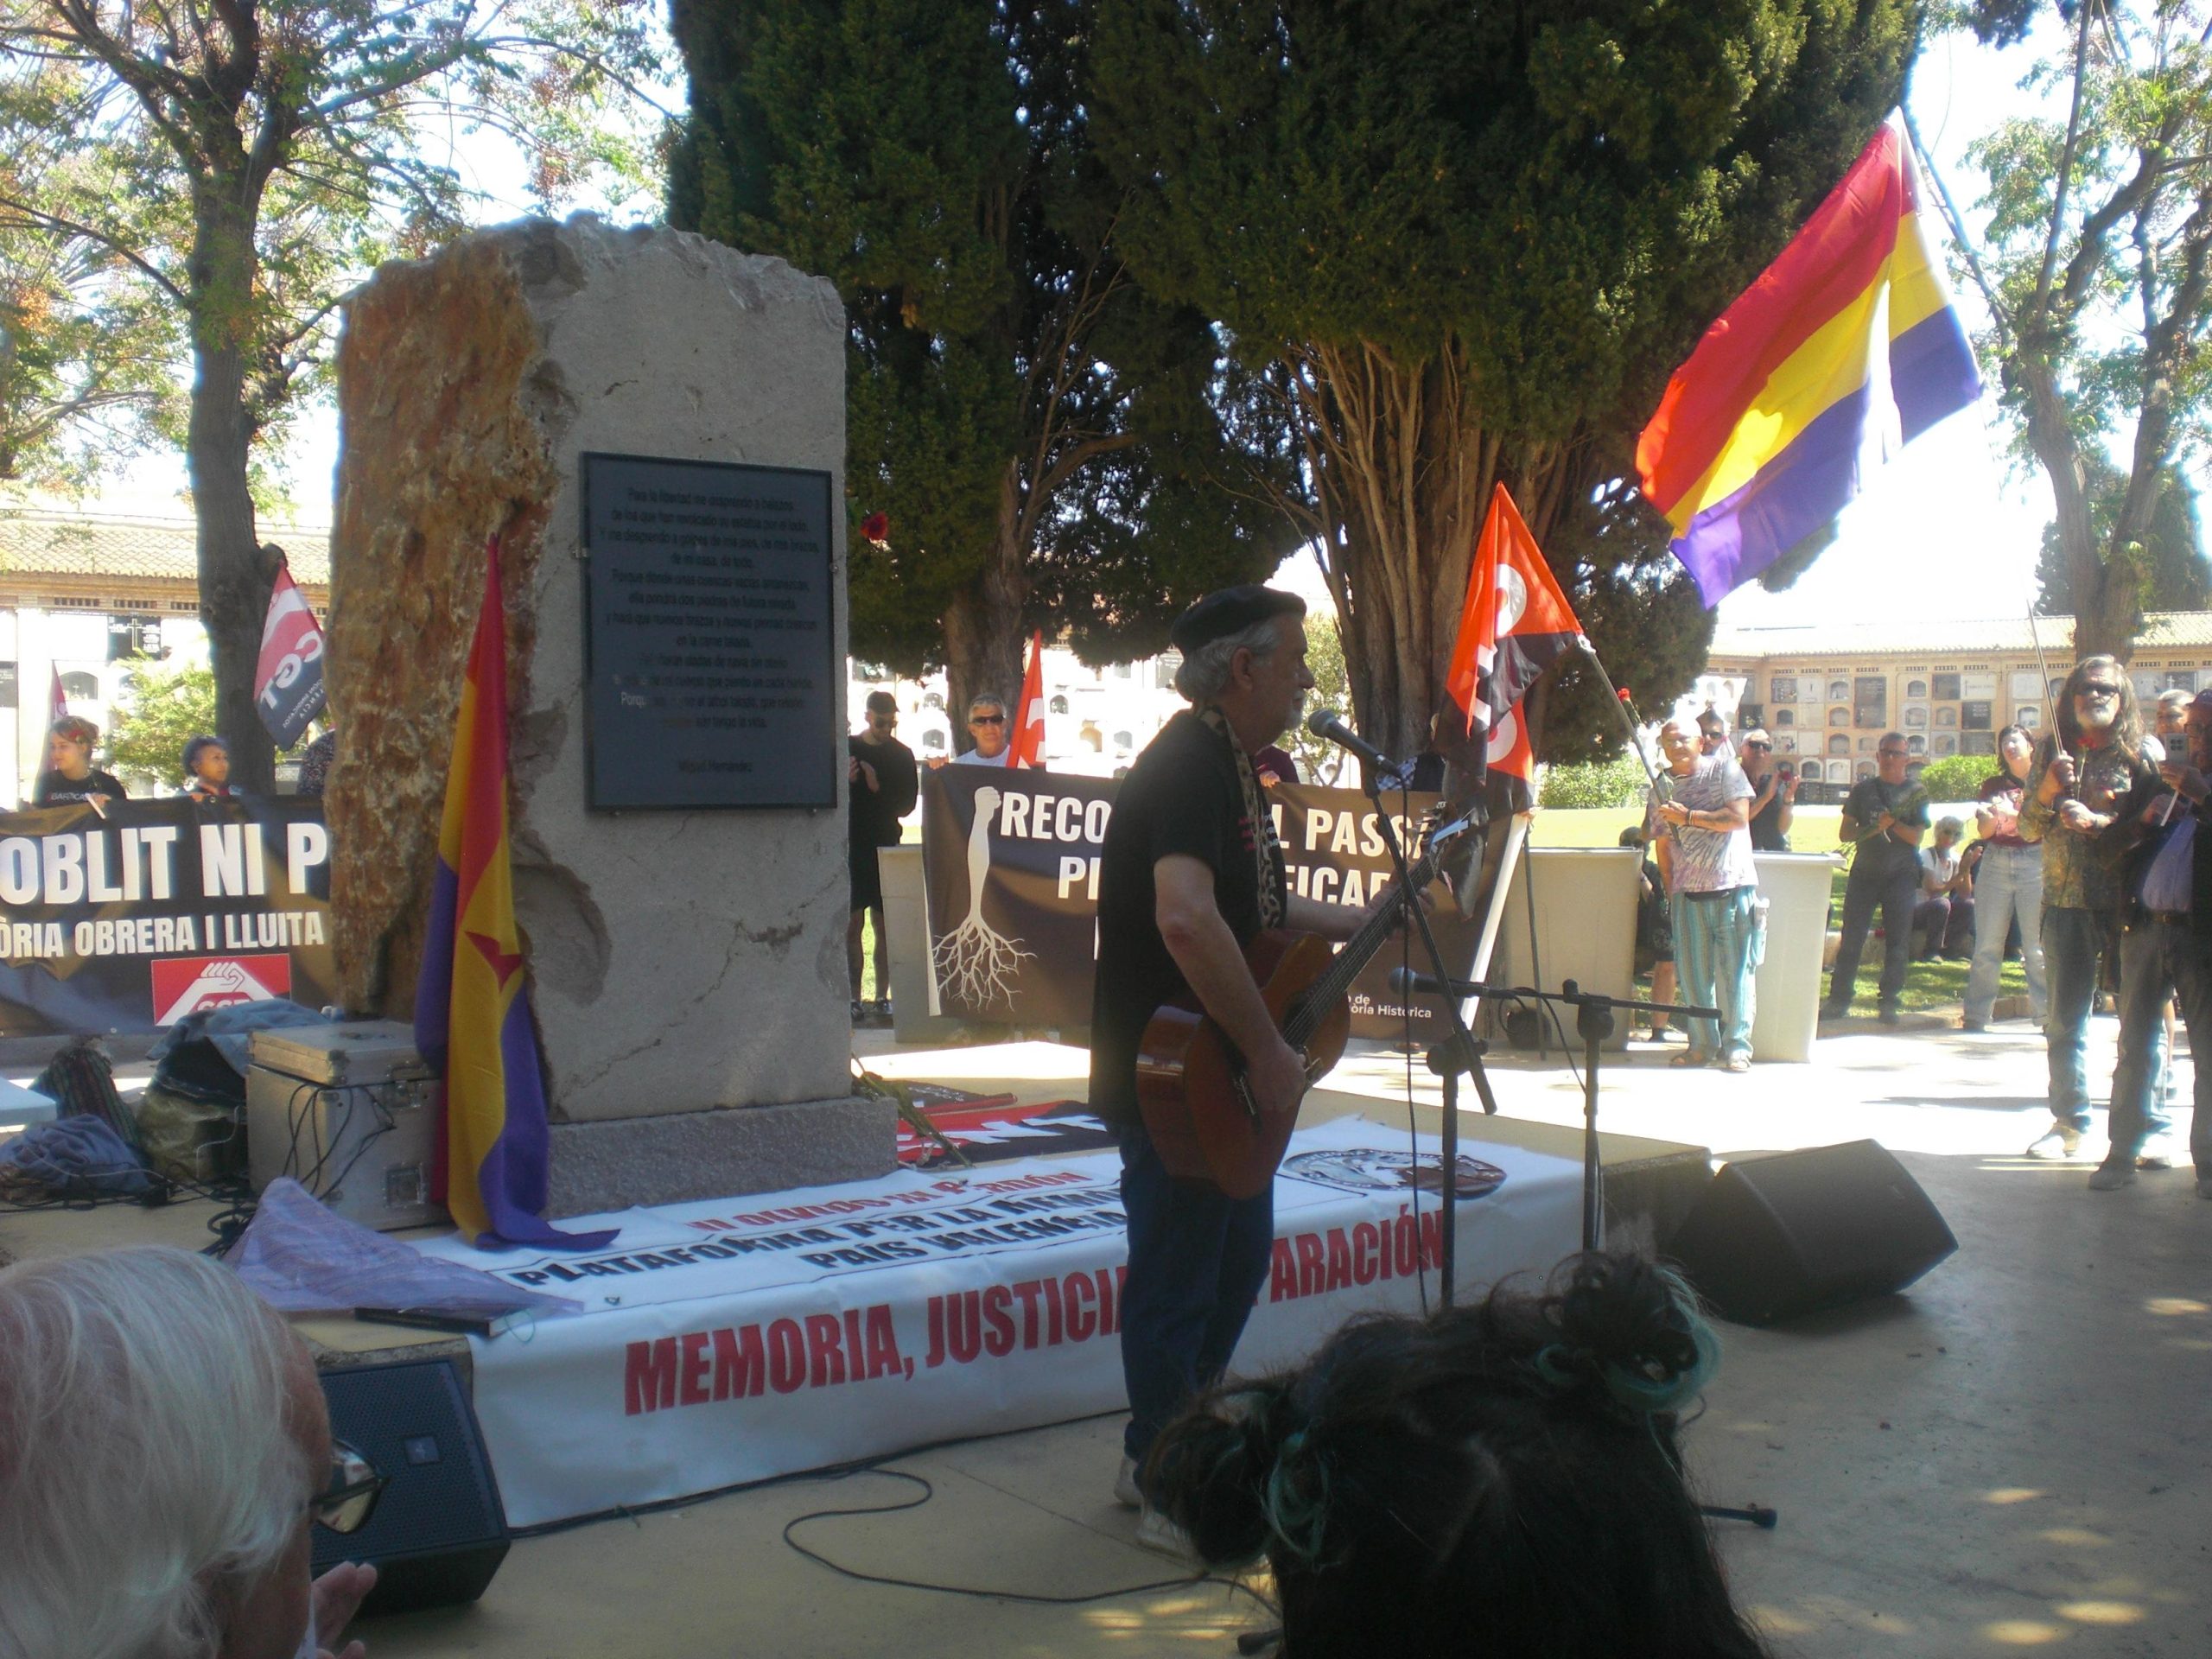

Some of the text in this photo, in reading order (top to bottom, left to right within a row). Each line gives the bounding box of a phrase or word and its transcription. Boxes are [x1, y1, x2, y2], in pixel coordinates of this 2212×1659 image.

[1001, 791, 1112, 843] RECO
[1271, 804, 1290, 849] L
[0, 822, 327, 905] OBLIT NI P
[74, 916, 196, 957] OBRERA
[205, 915, 217, 950] I
[225, 912, 324, 950] LLUITA
[506, 1228, 850, 1286] PLATAFORMA
[838, 1213, 943, 1238] PER
[931, 1207, 1006, 1227] LA
[798, 1240, 928, 1268] PAÍS
[625, 1304, 915, 1416] MEMORIA,
[1269, 1203, 1444, 1304] ARACIÓN
